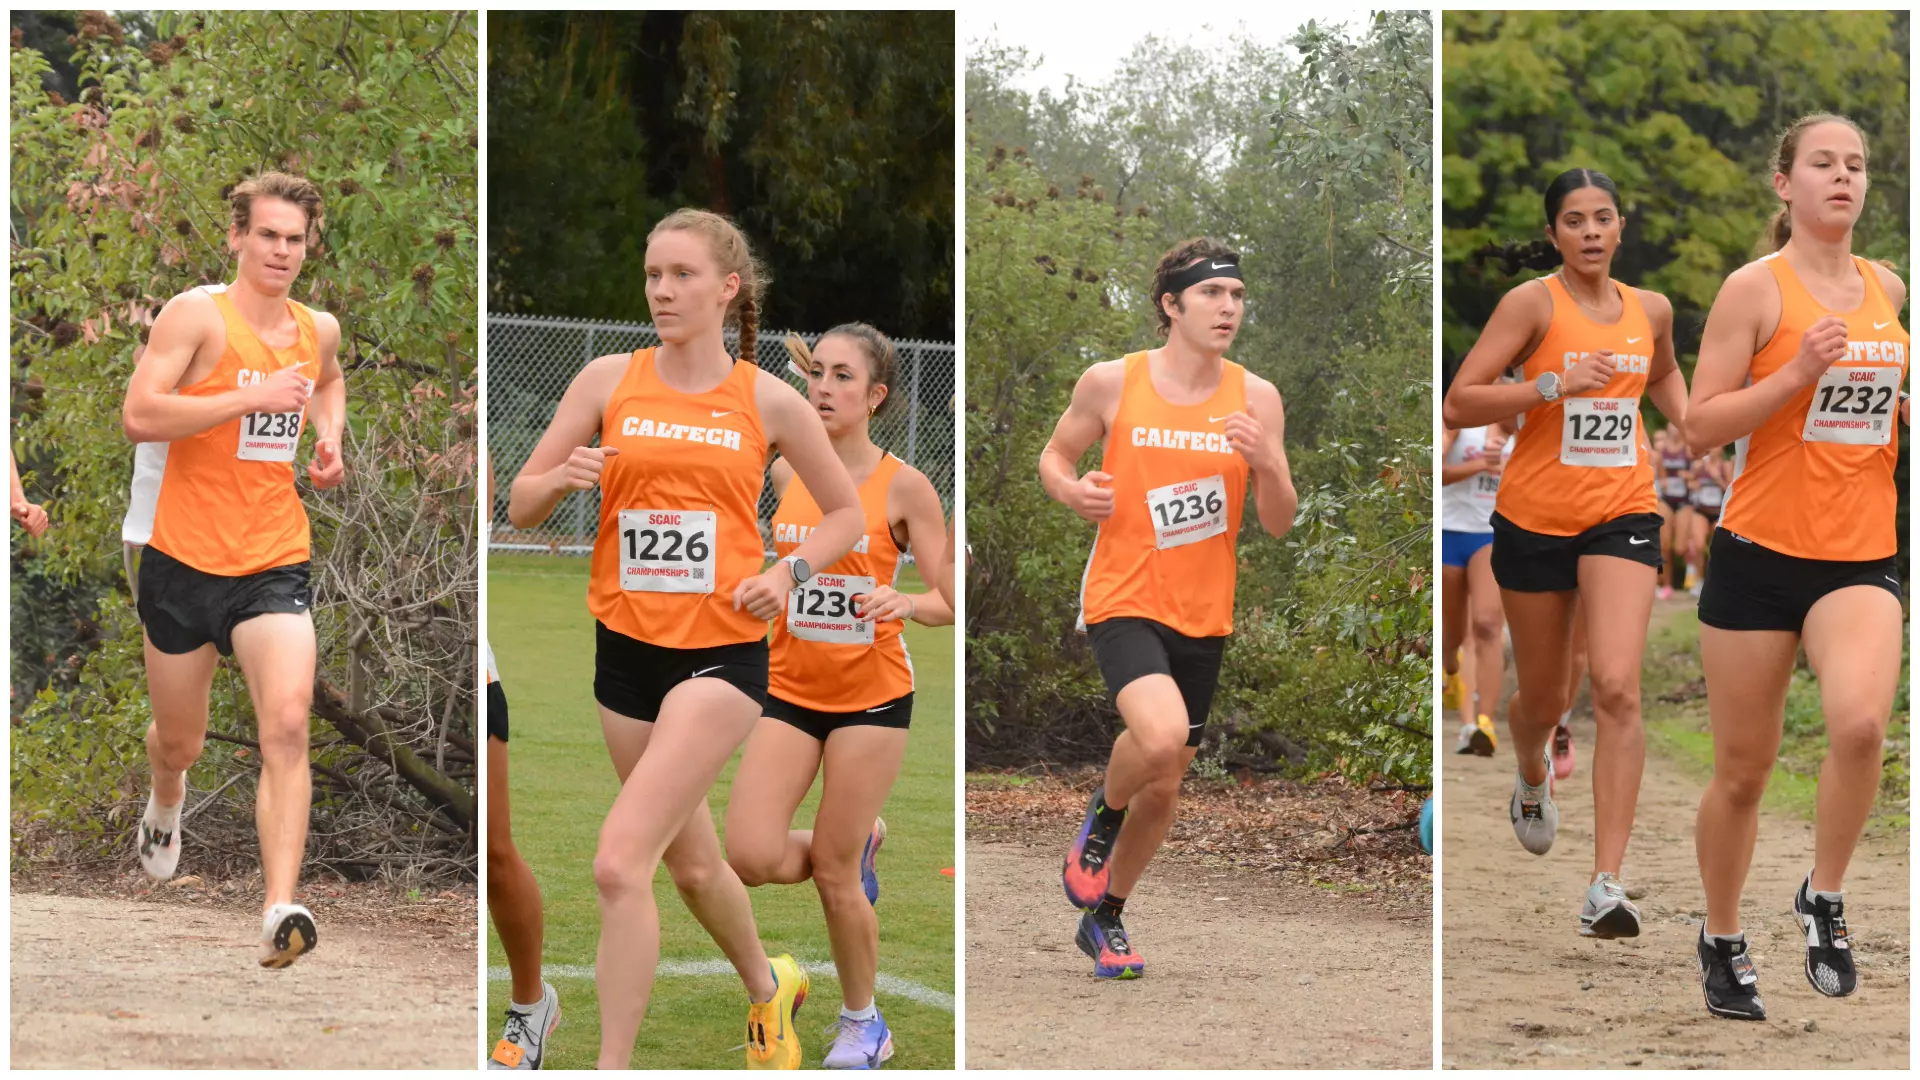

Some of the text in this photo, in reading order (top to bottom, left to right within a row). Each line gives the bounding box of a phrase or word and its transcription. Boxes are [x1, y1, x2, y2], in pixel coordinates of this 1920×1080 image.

[1563, 351, 1648, 375] CECH
[1848, 371, 1876, 382] SCAIC
[1593, 401, 1618, 411] SCAIC
[1819, 385, 1893, 415] 1232
[245, 412, 300, 438] 1238
[1569, 414, 1632, 440] 1229
[1813, 419, 1870, 429] CHAMPIONSHIPS
[622, 416, 741, 451] CALTECH
[245, 441, 288, 450] CHAMPIONSHIPS
[1569, 445, 1621, 455] CHAMPIONSHIPS
[1172, 482, 1198, 496] SCAIC
[1154, 489, 1222, 527] 1236
[648, 513, 681, 525] SCAIC
[1162, 520, 1211, 538] CHAMPIONSHIPS
[623, 528, 709, 562] 1226
[626, 566, 689, 577] CHAMPIONSHIPS
[817, 576, 845, 587] SCAIC
[794, 620, 852, 631] CHAMPIONSHIPS
